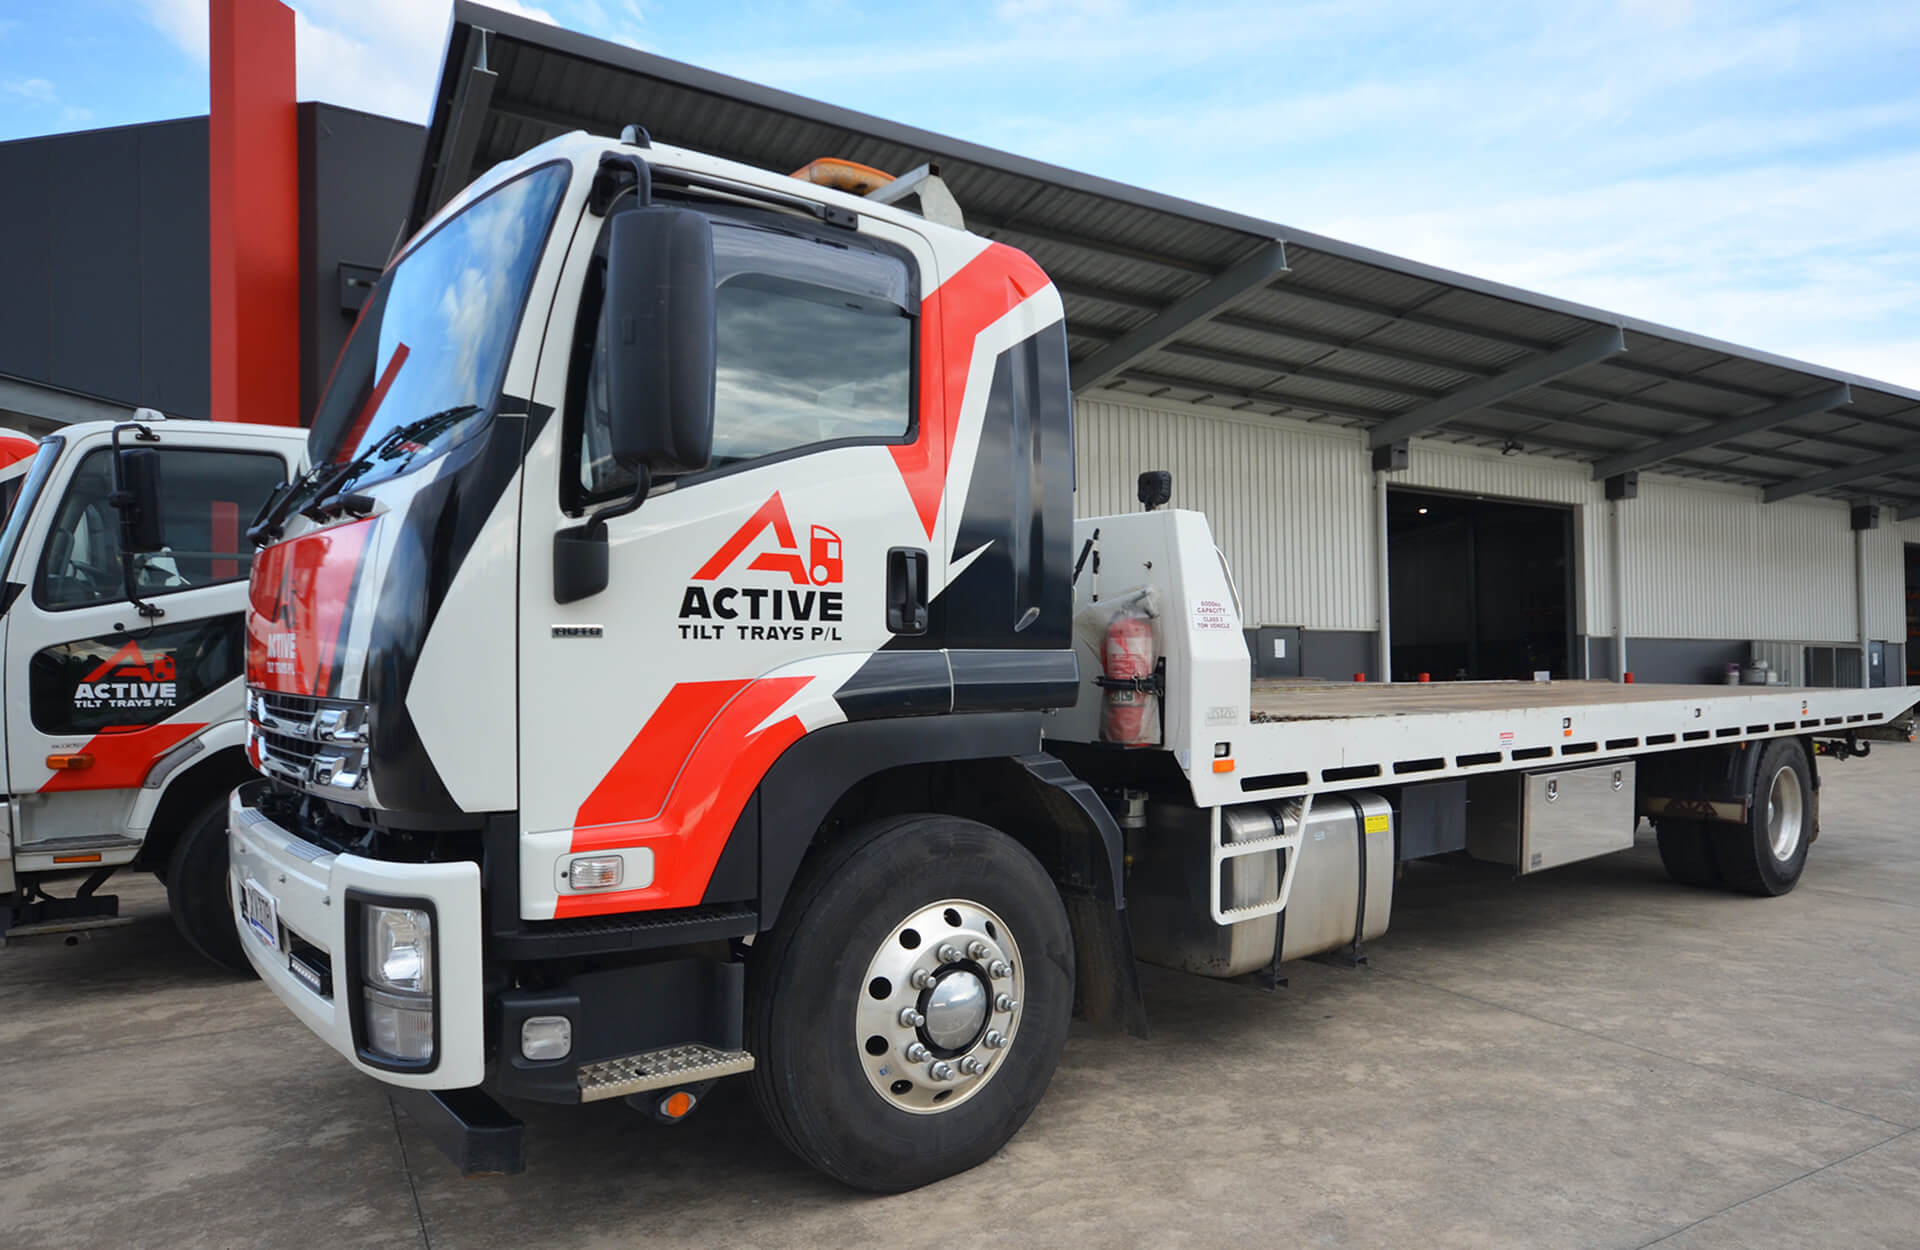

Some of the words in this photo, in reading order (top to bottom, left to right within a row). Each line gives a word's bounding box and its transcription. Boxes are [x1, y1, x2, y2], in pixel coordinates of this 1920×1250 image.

[678, 586, 843, 621] ACTIVE
[678, 625, 724, 640] TILT
[737, 625, 804, 641] TRAYS
[811, 627, 842, 641] P/L
[74, 683, 176, 699] ACTIVE
[74, 700, 102, 708] TILT
[109, 699, 152, 707] TRAYS
[155, 699, 176, 707] P/L
